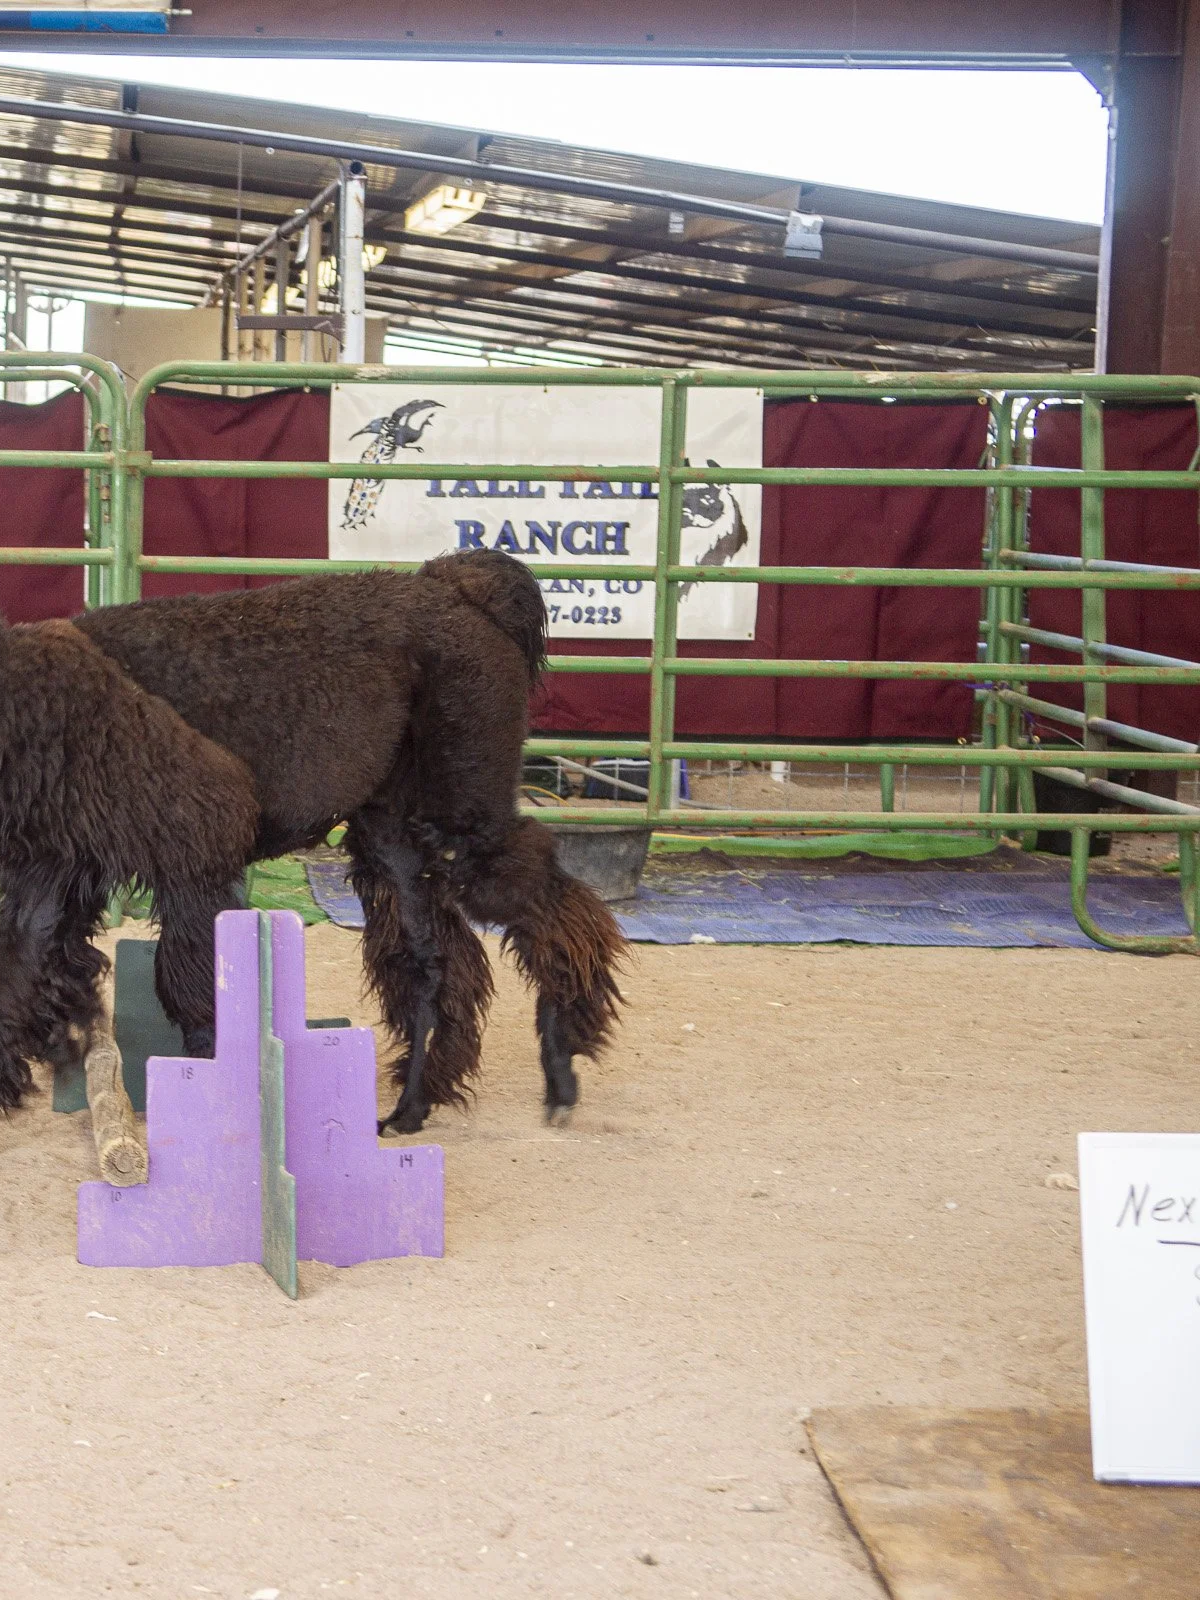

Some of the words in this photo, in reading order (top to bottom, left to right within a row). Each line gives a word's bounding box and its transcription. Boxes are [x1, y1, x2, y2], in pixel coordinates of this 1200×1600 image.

[455, 519, 630, 555] RANCH
[604, 579, 643, 594] CO
[548, 604, 622, 624] 7-0223
[399, 1154, 413, 1168] 14
[1116, 1183, 1196, 1227] Nex
